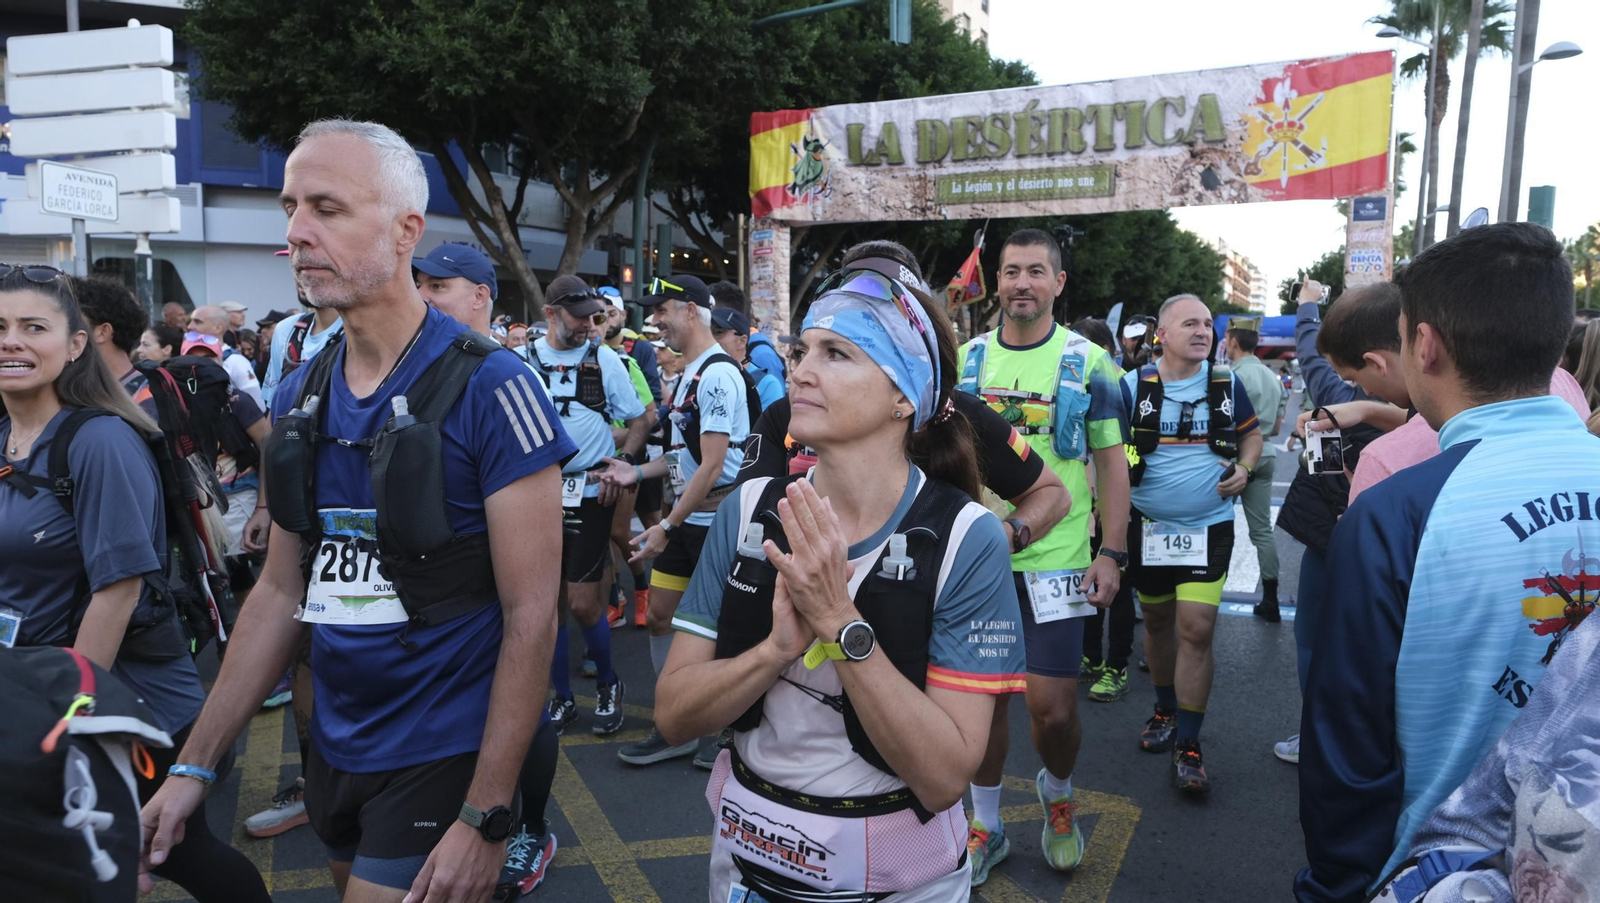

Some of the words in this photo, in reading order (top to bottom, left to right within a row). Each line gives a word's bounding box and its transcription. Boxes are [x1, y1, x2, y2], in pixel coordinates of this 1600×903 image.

[846, 122, 904, 166] LA
[915, 93, 1227, 164] DESÉRTICA
[65, 172, 114, 188] AVENIDA
[952, 181, 962, 193] La
[965, 179, 993, 194] Legión
[997, 181, 1003, 193] y
[1006, 178, 1015, 190] el
[1018, 177, 1054, 190] desierto
[1057, 177, 1073, 188] nos
[1078, 176, 1095, 187] une
[58, 183, 102, 202] FEDERICO
[84, 202, 114, 217] LORCA
[1351, 255, 1382, 263] RENTA
[1500, 492, 1600, 543] LEGI
[1163, 534, 1193, 550] 149
[320, 543, 393, 583] 287
[971, 620, 983, 630] LA
[985, 618, 1010, 630] LEGIÓN
[1011, 621, 1016, 630] Y
[968, 633, 981, 643] EL
[982, 634, 1017, 644] DESIERTO
[979, 647, 997, 658] NOS
[721, 805, 826, 861] Gaucín
[721, 817, 827, 873] TRAIL
